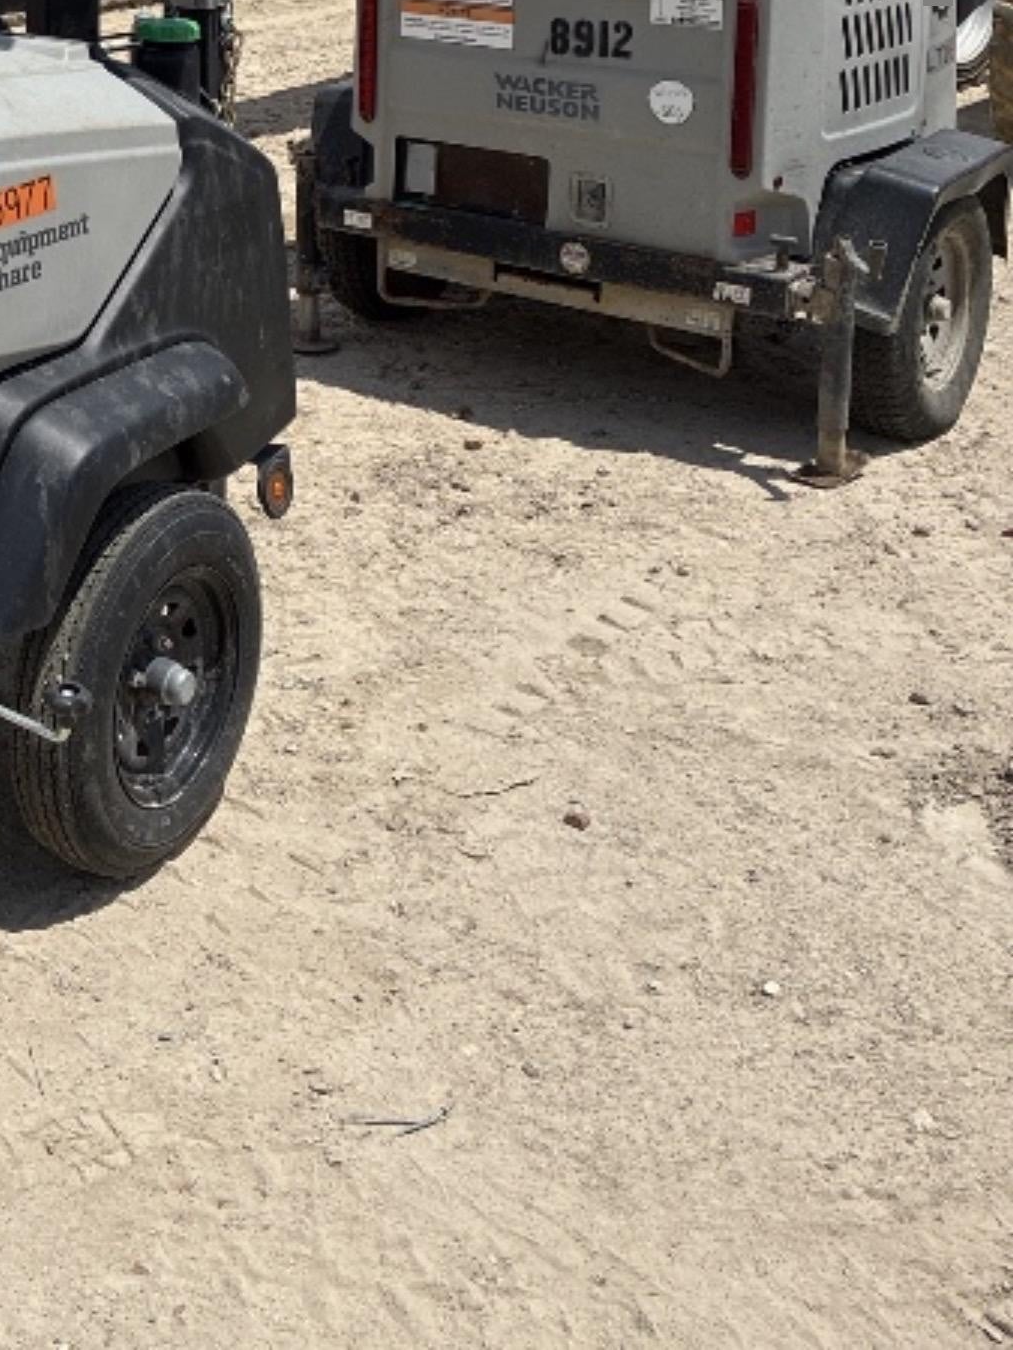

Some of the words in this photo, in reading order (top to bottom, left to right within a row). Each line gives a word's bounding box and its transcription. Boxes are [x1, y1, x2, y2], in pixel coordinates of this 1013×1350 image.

[549, 16, 634, 59] 8912
[493, 71, 599, 101] WACKER
[495, 92, 601, 121] NEUSON
